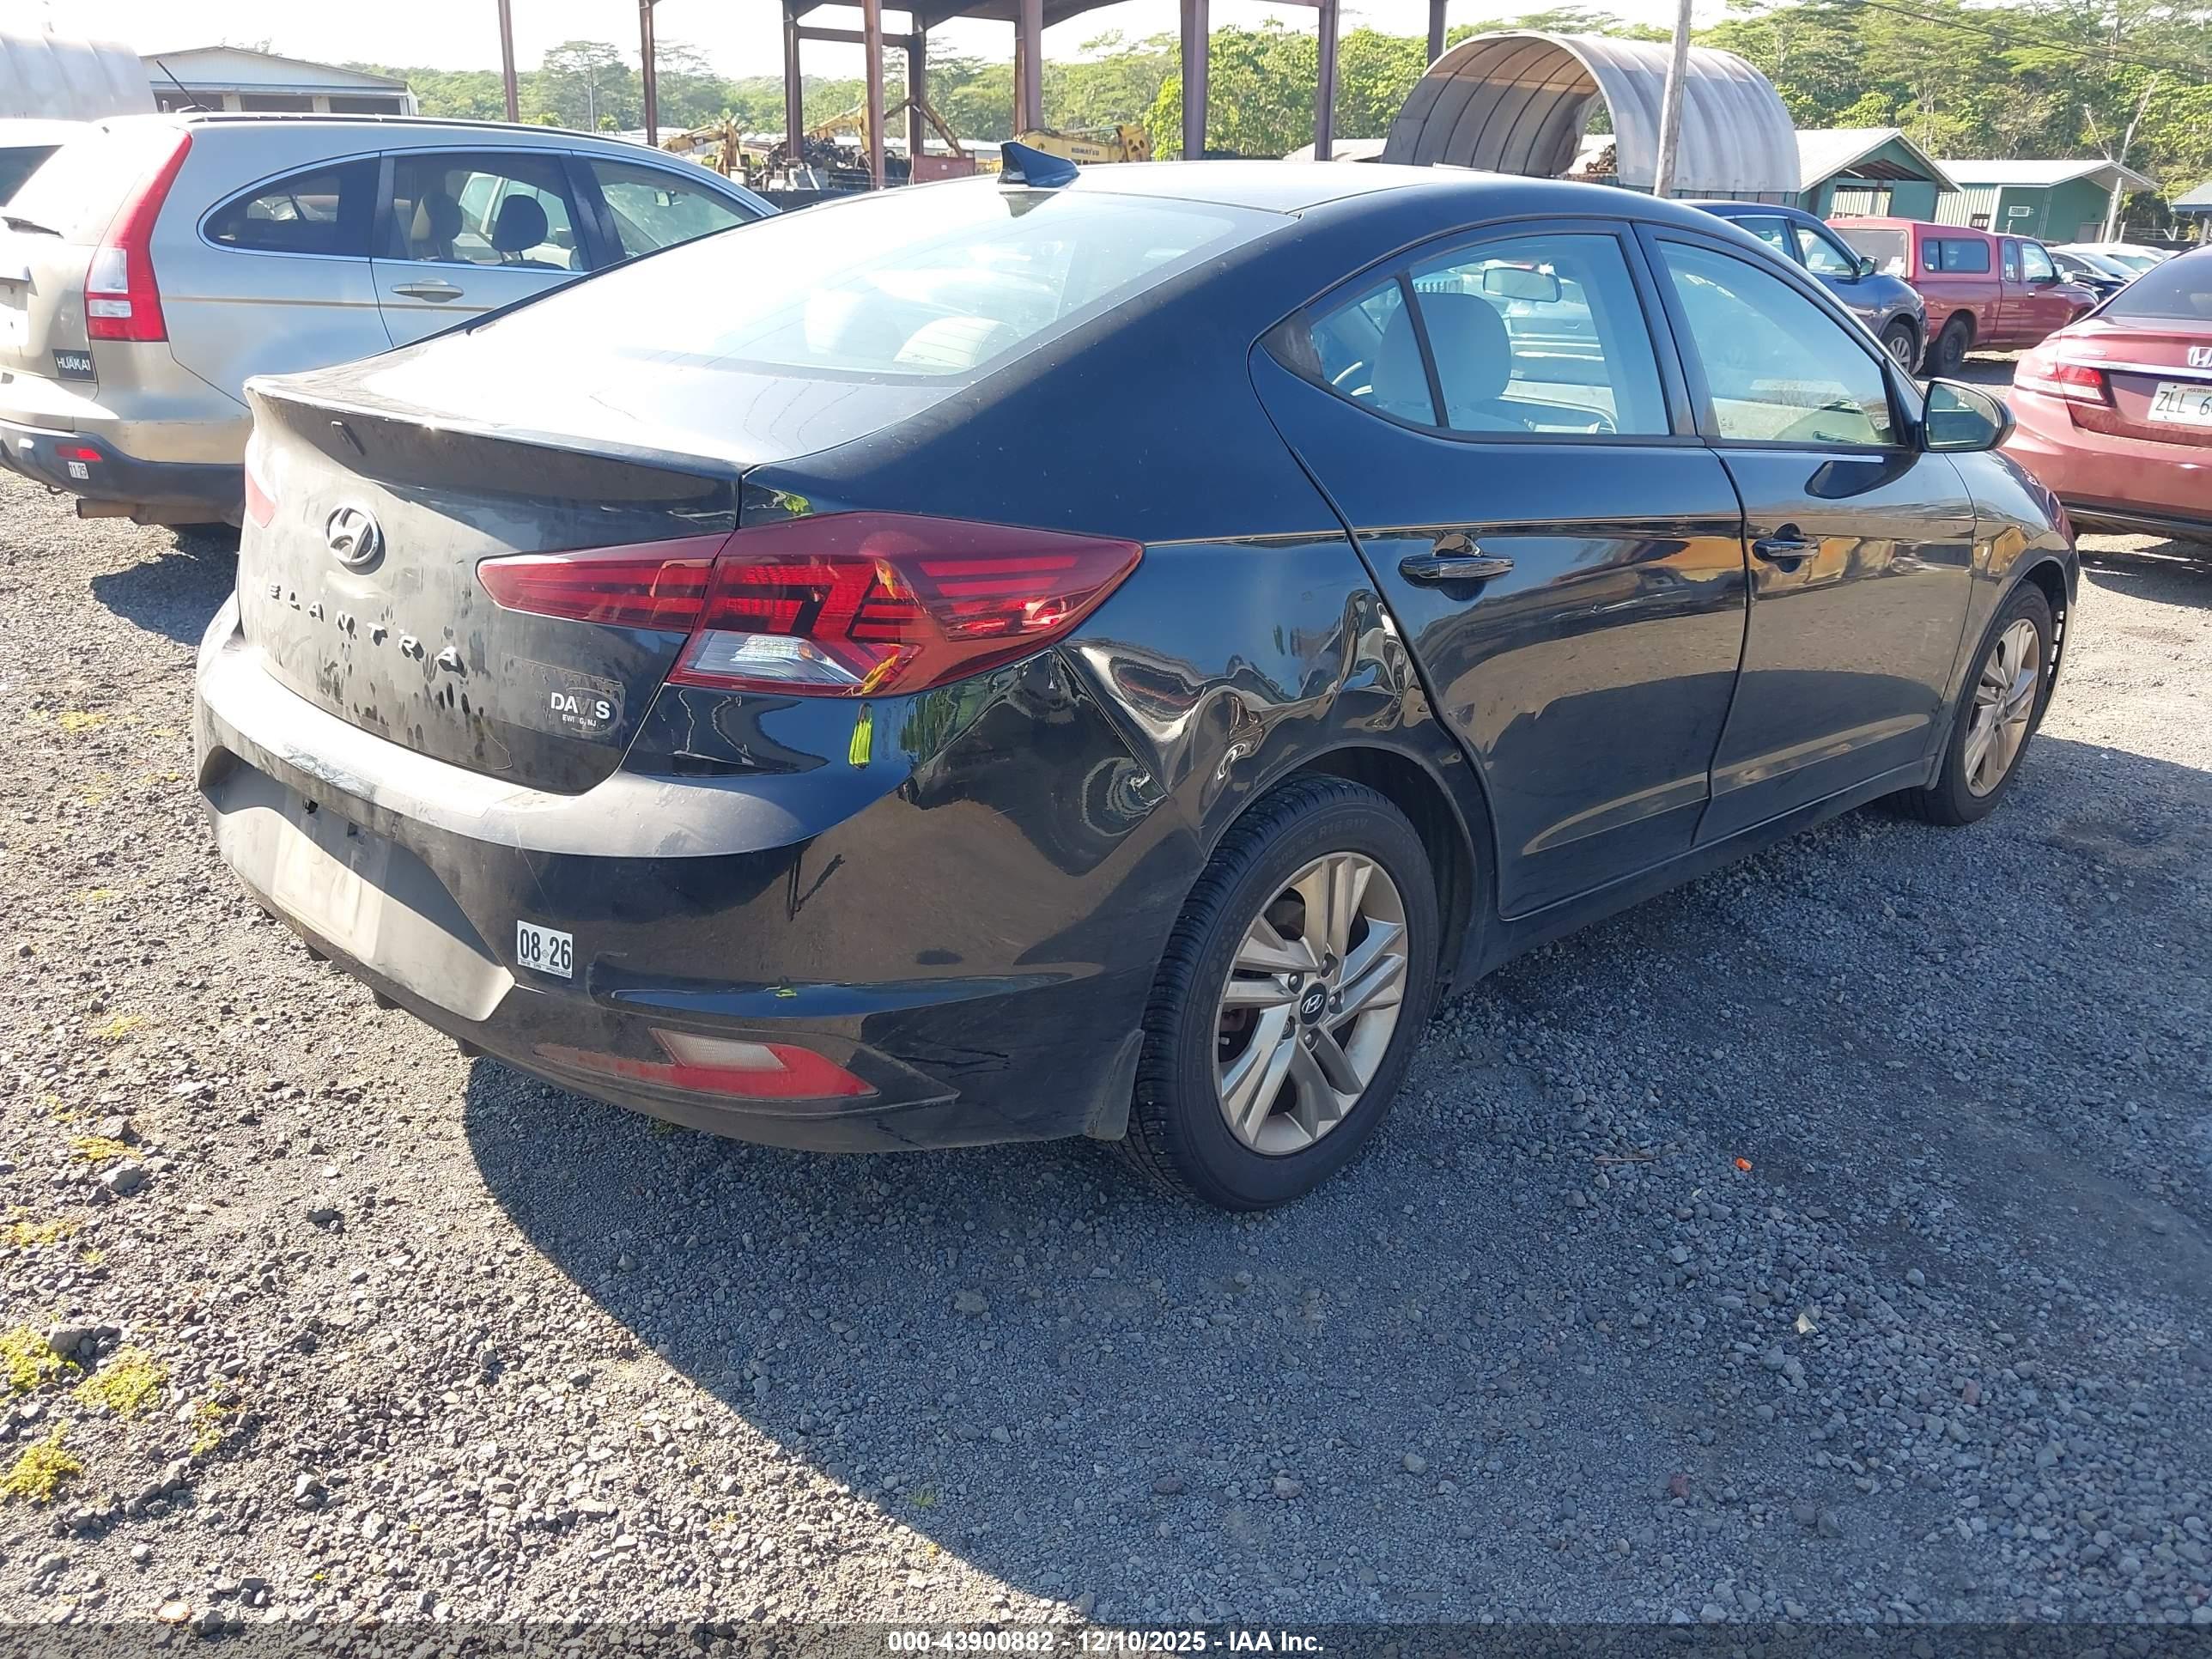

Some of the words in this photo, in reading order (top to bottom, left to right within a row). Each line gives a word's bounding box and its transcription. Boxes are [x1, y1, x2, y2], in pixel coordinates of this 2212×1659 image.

[1071, 147, 1100, 156] KOMATSU
[55, 356, 91, 371] HUAKAI
[2155, 391, 2185, 414] ZLL
[2199, 395, 2212, 416] 6
[269, 584, 461, 670] ELANTRA
[550, 691, 611, 720] DAVIS
[562, 714, 586, 727] EWIG,
[587, 719, 597, 727] NJ
[520, 928, 541, 963] 08
[550, 936, 572, 970] 26
